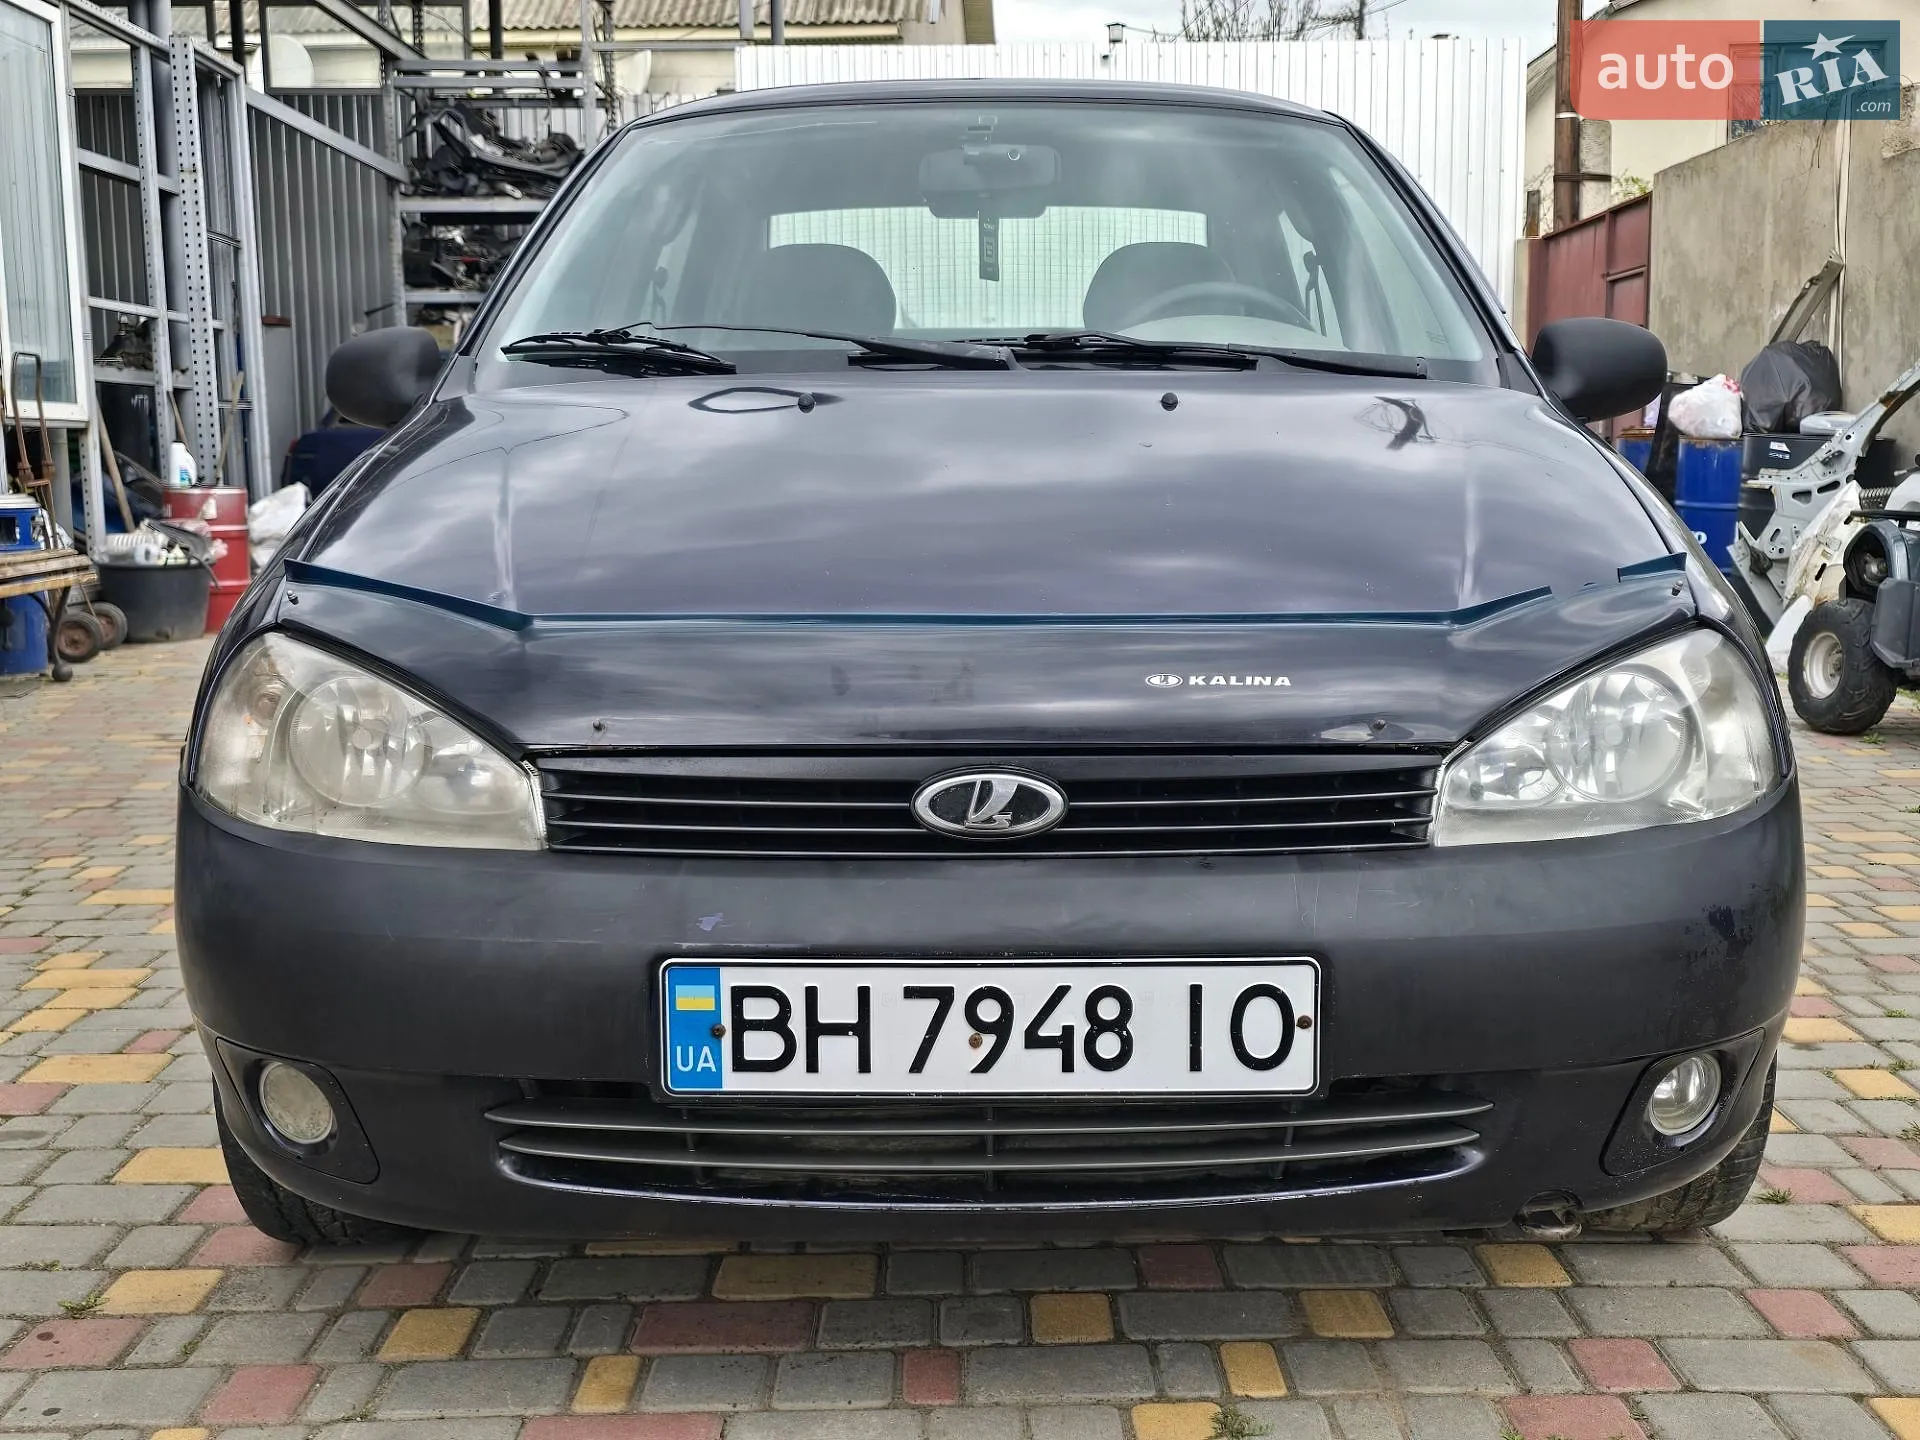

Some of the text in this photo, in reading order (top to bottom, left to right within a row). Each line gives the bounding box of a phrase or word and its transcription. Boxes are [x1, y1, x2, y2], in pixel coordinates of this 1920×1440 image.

[1188, 675, 1293, 687] KALINA
[730, 984, 1296, 1074] BH 7948 IO
[675, 1045, 718, 1073] UA
